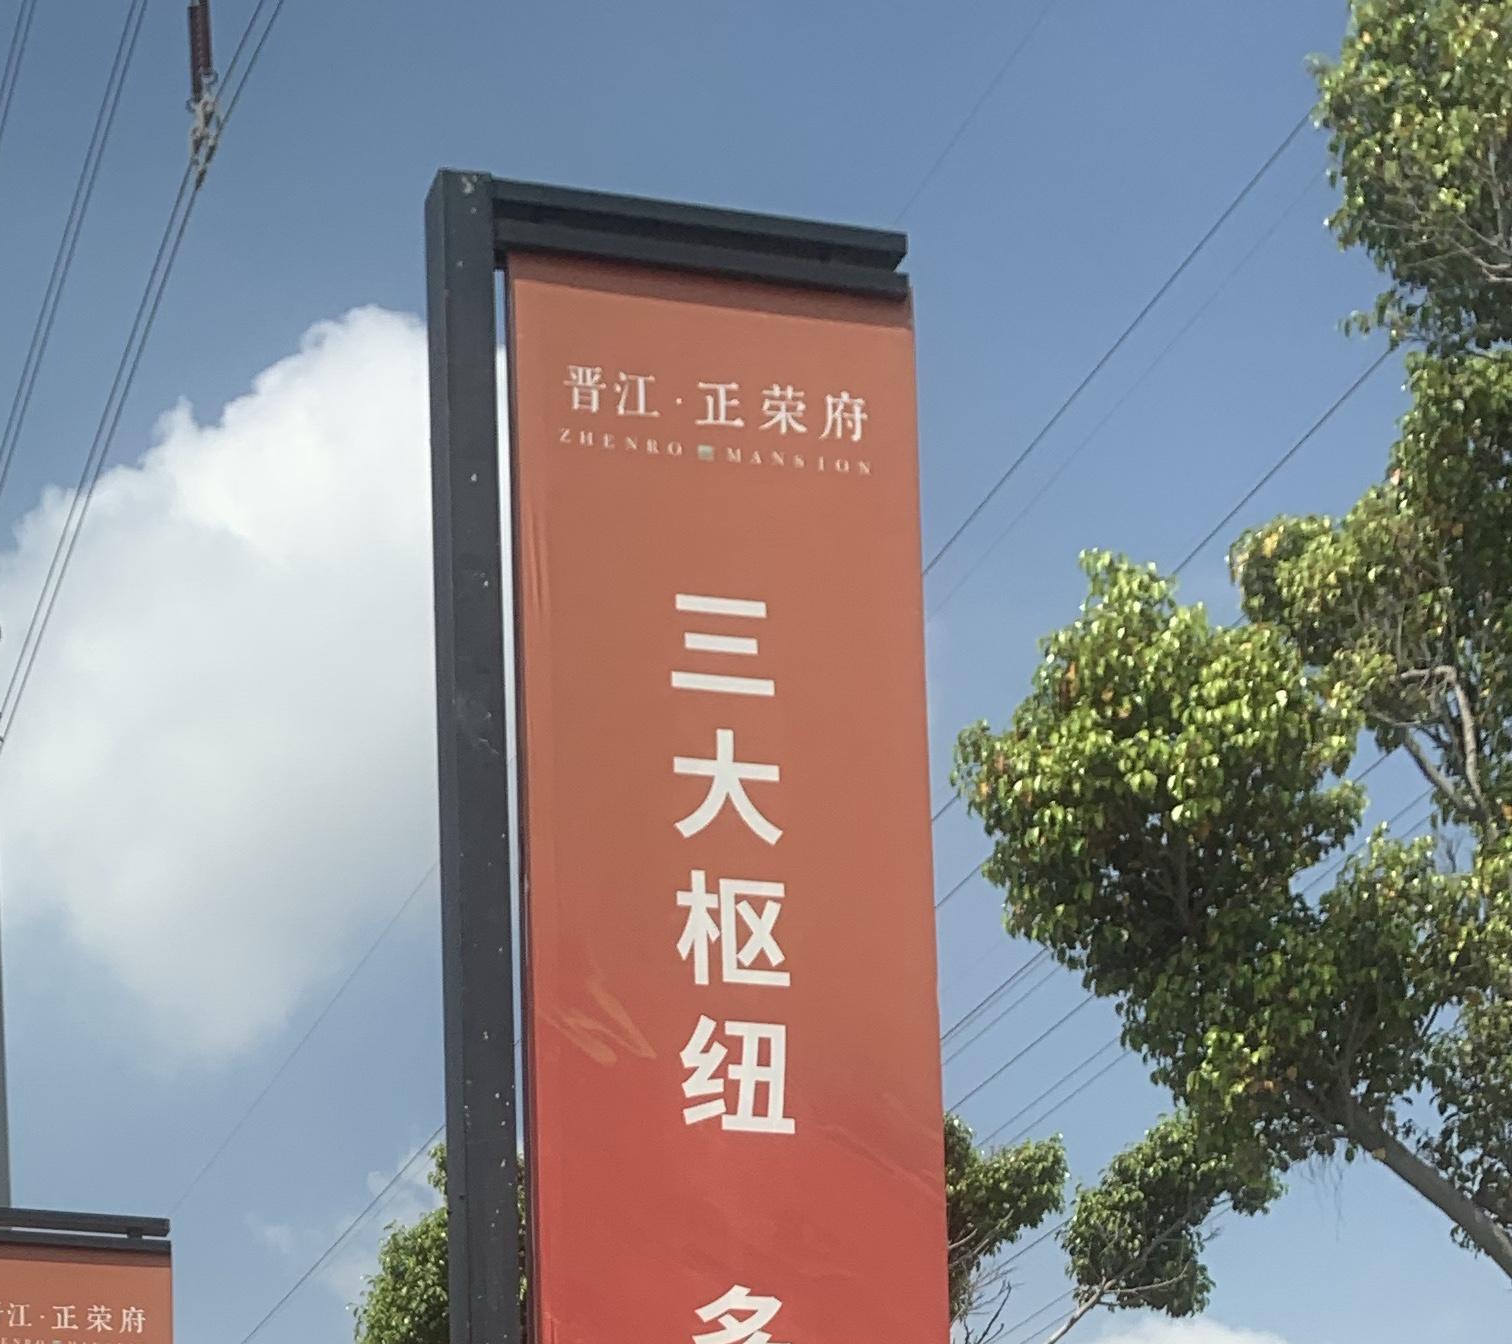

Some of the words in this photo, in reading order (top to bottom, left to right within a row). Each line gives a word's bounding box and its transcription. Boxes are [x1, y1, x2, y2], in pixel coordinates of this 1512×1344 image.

[559, 427, 683, 456] ZHENRO
[727, 447, 872, 475] MANSION
[671, 593, 796, 1135] 三大枢纽
